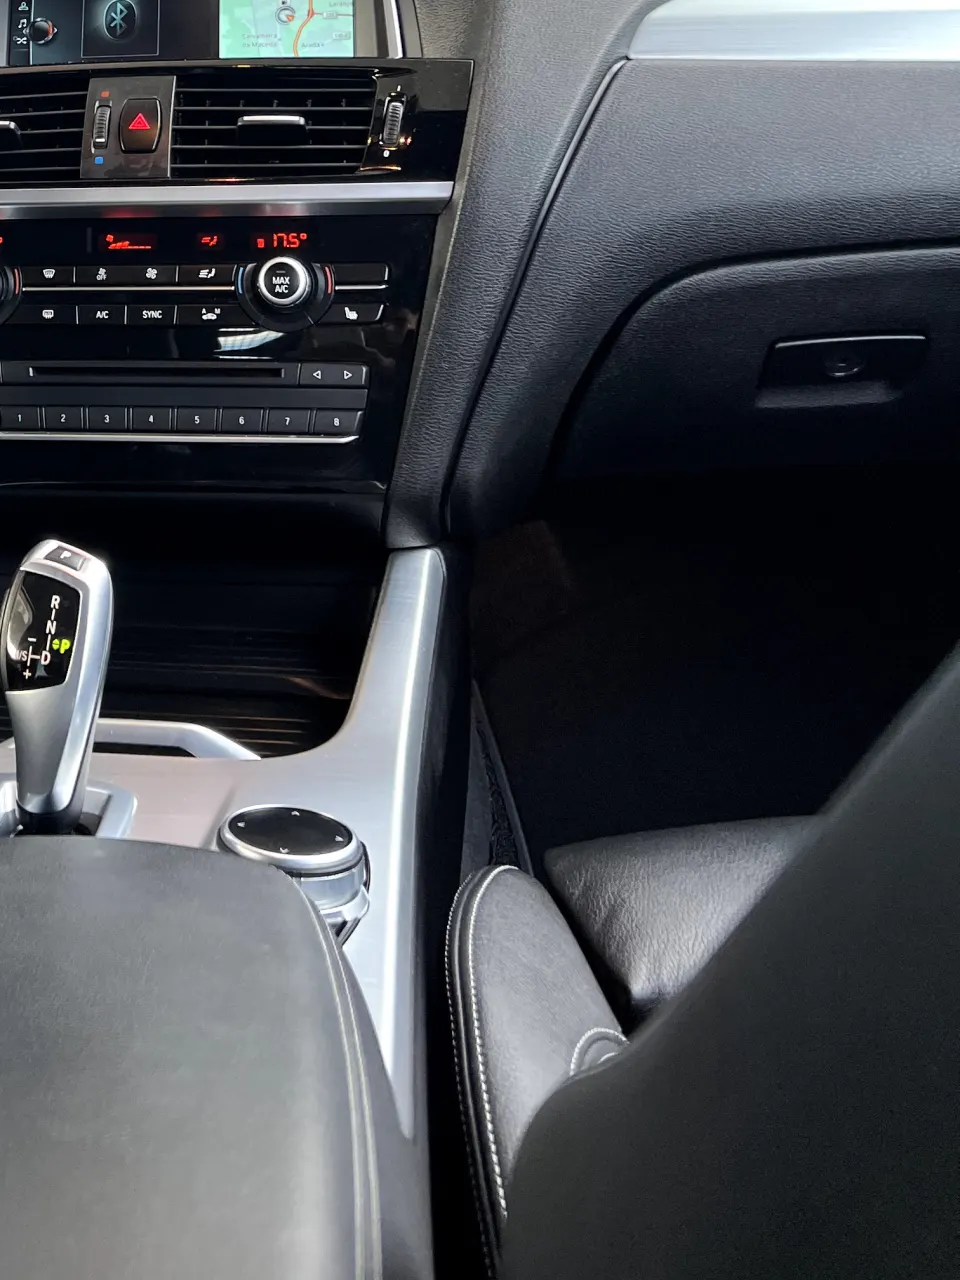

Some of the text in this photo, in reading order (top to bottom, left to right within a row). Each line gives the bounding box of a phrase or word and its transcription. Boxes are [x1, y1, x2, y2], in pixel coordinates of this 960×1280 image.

[272, 276, 290, 285] MAX
[274, 285, 289, 293] A/C
[95, 310, 110, 319] A/C
[142, 310, 163, 319] SYNC
[17, 414, 22, 422] 1
[60, 414, 66, 422] 2
[104, 415, 110, 423] 3
[148, 415, 154, 423] 4
[194, 416, 200, 424] 5
[239, 416, 245, 425] 6
[285, 417, 290, 425] 7
[333, 418, 340, 426] 8
[60, 550, 72, 559] P
[50, 595, 60, 609] R
[45, 620, 57, 635] N
[59, 638, 71, 654] P
[40, 651, 51, 665] D
